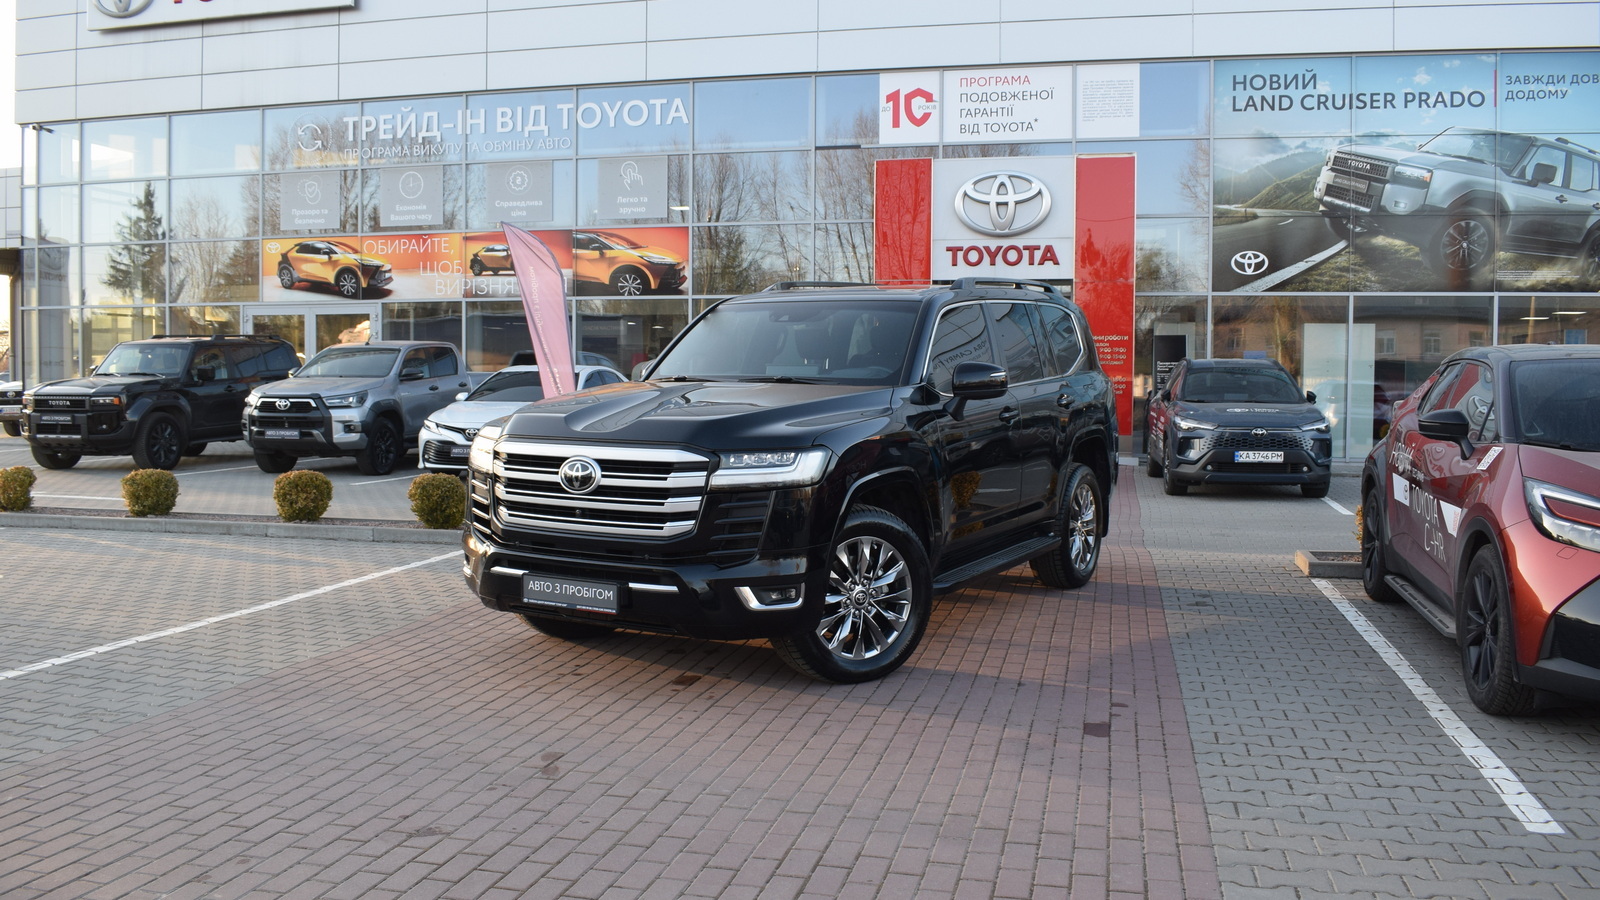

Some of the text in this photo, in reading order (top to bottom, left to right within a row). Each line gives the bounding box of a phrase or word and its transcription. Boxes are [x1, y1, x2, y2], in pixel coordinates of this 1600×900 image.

[959, 75, 1031, 88] ПРОГРАМА
[1232, 69, 1318, 92] НОВИЙ
[1505, 74, 1566, 86] ЗАВЖДИ
[959, 87, 1055, 104] ПОДОВЖЕНОЇ
[1232, 90, 1486, 113] LAND CRUISER PRADO
[1505, 89, 1568, 102] ДОДОМУ
[959, 104, 1014, 119] ГАРАНТІЇ
[343, 97, 690, 143] ТРЕЙД-ІН ВІД TOYOTA
[959, 122, 980, 136] ВІД
[344, 136, 571, 160] ПРОГРАМА ВИКУПУ ТА ОБМІНУ АВТО
[1347, 160, 1371, 170] TOYOTA
[495, 199, 543, 208] Справедлива
[616, 196, 638, 204] Легко
[291, 208, 319, 217] Прозоро
[395, 204, 427, 212] Економія
[510, 209, 527, 218] ціна
[618, 206, 646, 215] зручно
[294, 217, 326, 225] безпечно
[390, 213, 433, 222] Вашого часу
[363, 235, 454, 255] ОБИРАЙТЕ,
[945, 245, 1060, 267] TOYOTA
[419, 260, 463, 277] ЩОБ
[1104, 334, 1129, 342] роботи
[1239, 452, 1283, 460] KA 3746 PM
[1411, 484, 1440, 528] TOYOTA
[1424, 523, 1446, 563] C-HR
[528, 580, 614, 601] АВТО З ПРОБІГОМ
